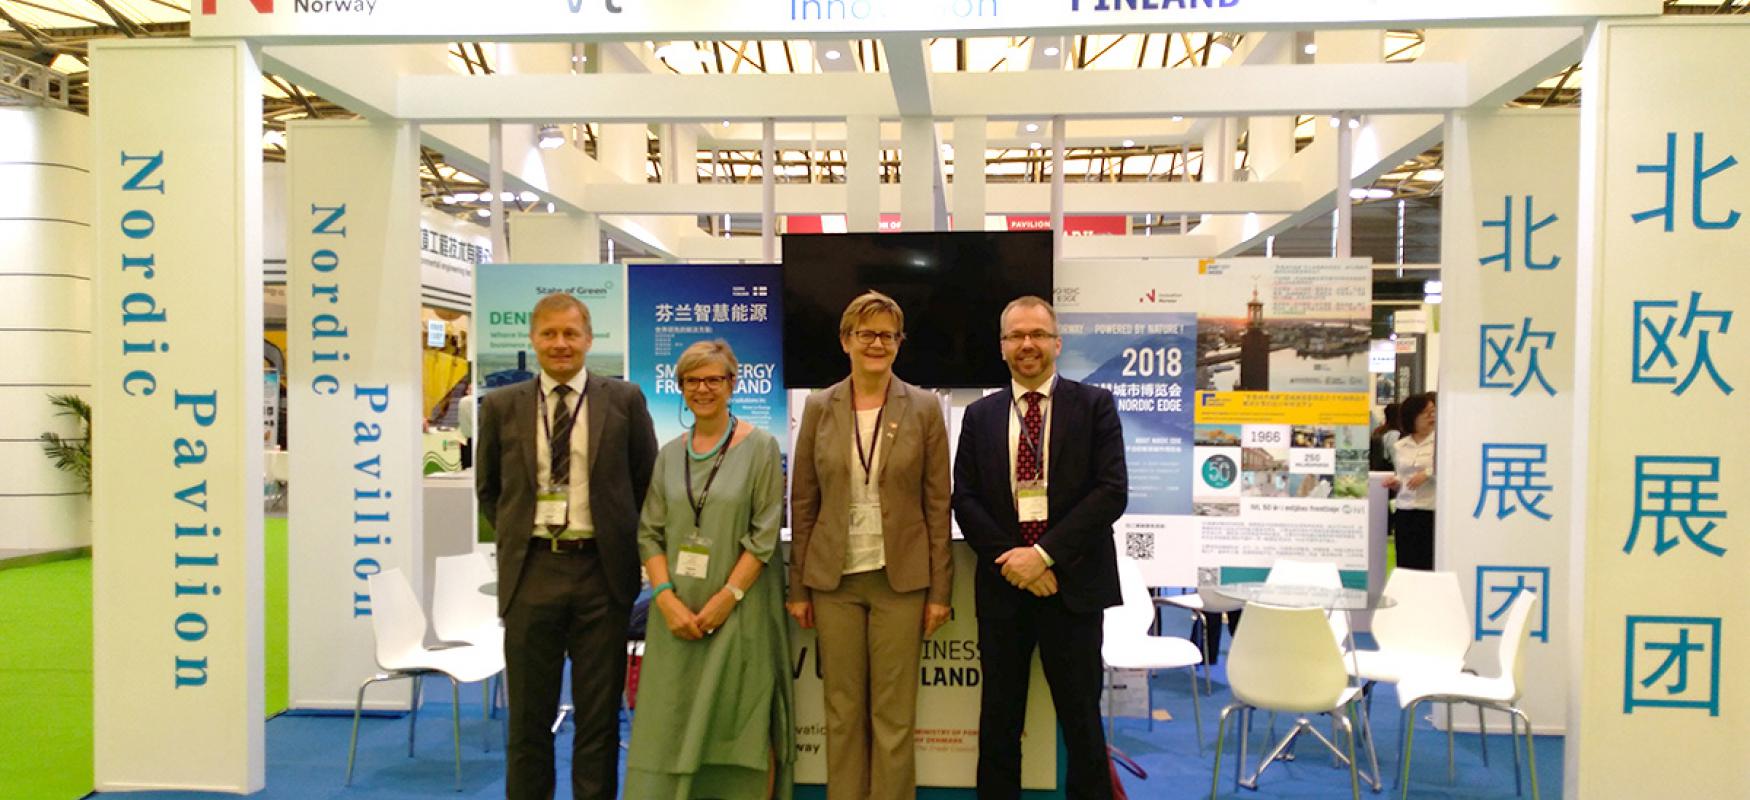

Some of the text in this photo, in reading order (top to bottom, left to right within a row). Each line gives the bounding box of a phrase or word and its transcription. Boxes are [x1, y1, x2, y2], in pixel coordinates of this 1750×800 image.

[120, 150, 169, 396] Nordic
[311, 203, 350, 396] Nordic
[577, 286, 607, 295] Green
[490, 311, 531, 326] DEN
[655, 303, 768, 322] 芬兰智慧能源
[655, 363, 775, 379] SM ERGY
[1122, 347, 1182, 377] 2018
[733, 379, 772, 394] AND
[1118, 398, 1182, 412] NORDIC EDGE
[1472, 194, 1561, 644] 北欧展团
[1622, 131, 1741, 717] 北欧展团
[1250, 430, 1281, 443] 1966
[1208, 462, 1230, 482] 50
[174, 389, 221, 689] Pavilion
[921, 667, 979, 687] LAND
